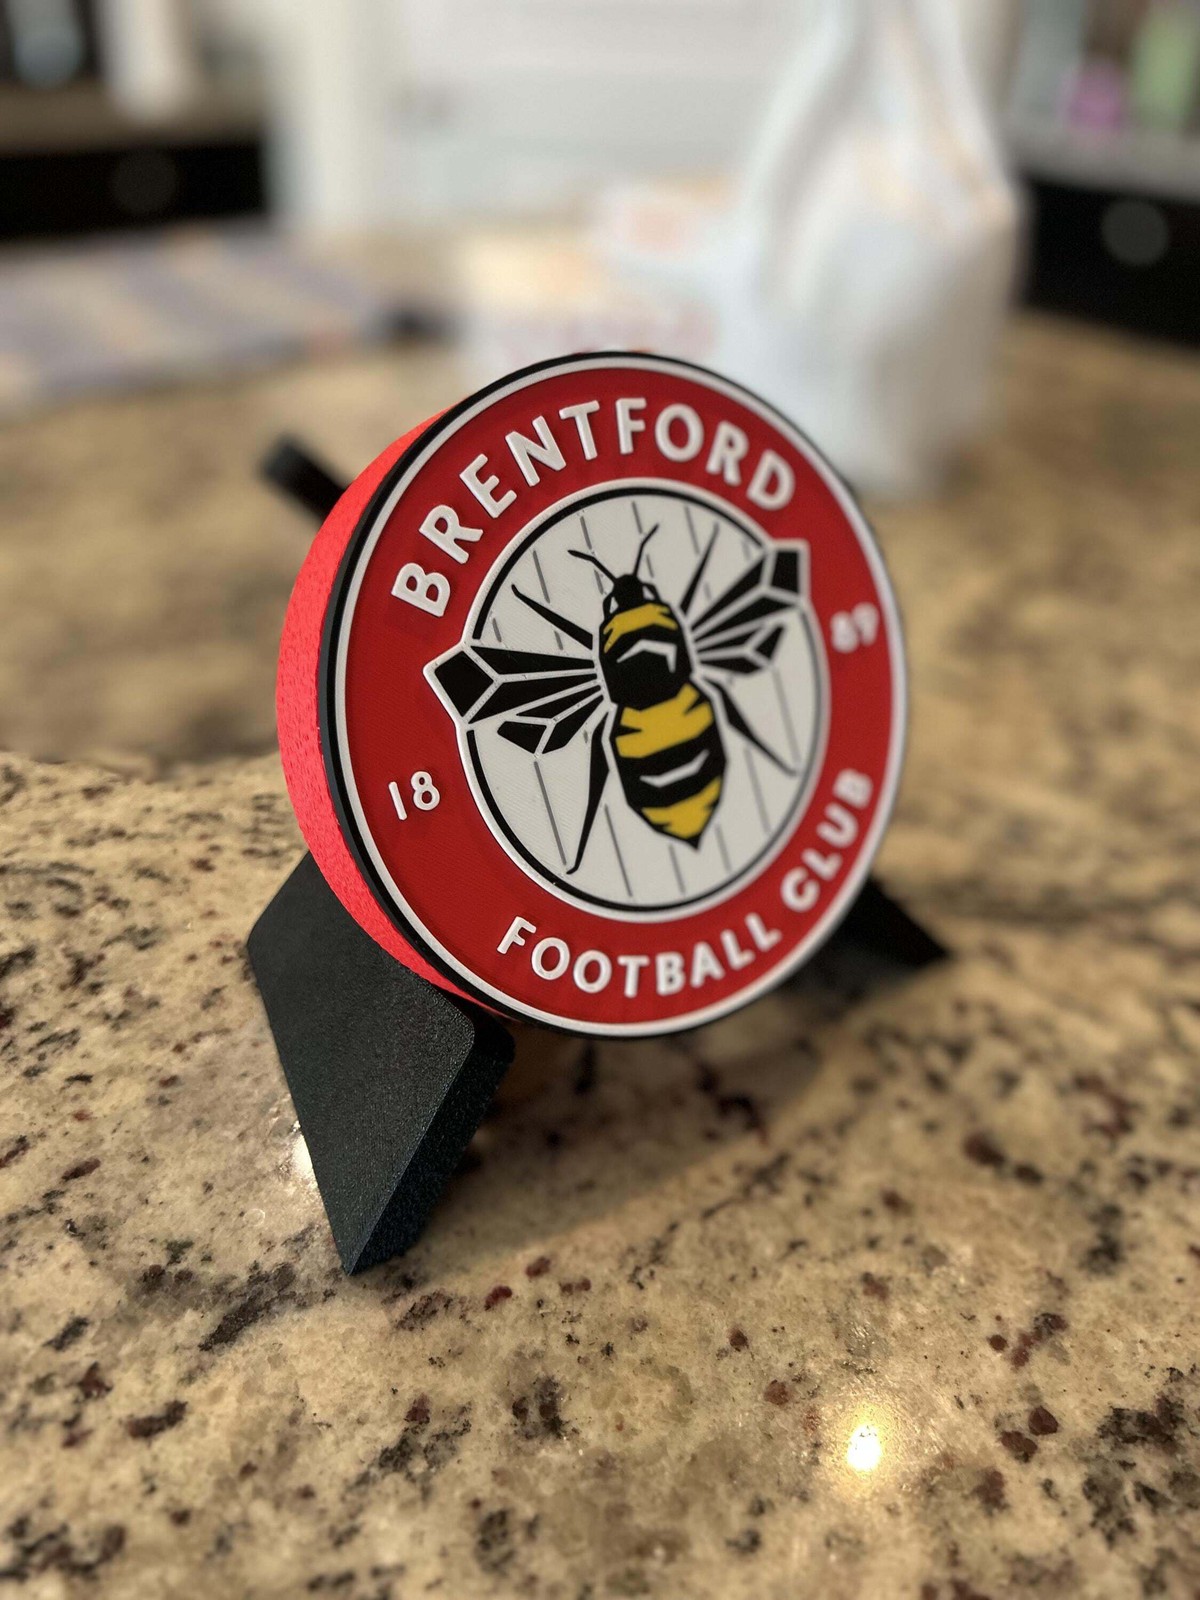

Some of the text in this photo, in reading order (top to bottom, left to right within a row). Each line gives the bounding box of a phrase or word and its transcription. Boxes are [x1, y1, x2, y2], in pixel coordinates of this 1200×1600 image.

[391, 397, 795, 616] BRENTFORD
[830, 602, 879, 652] 89
[388, 771, 441, 821] 18
[496, 769, 872, 998] FOOTBALL CLUB
